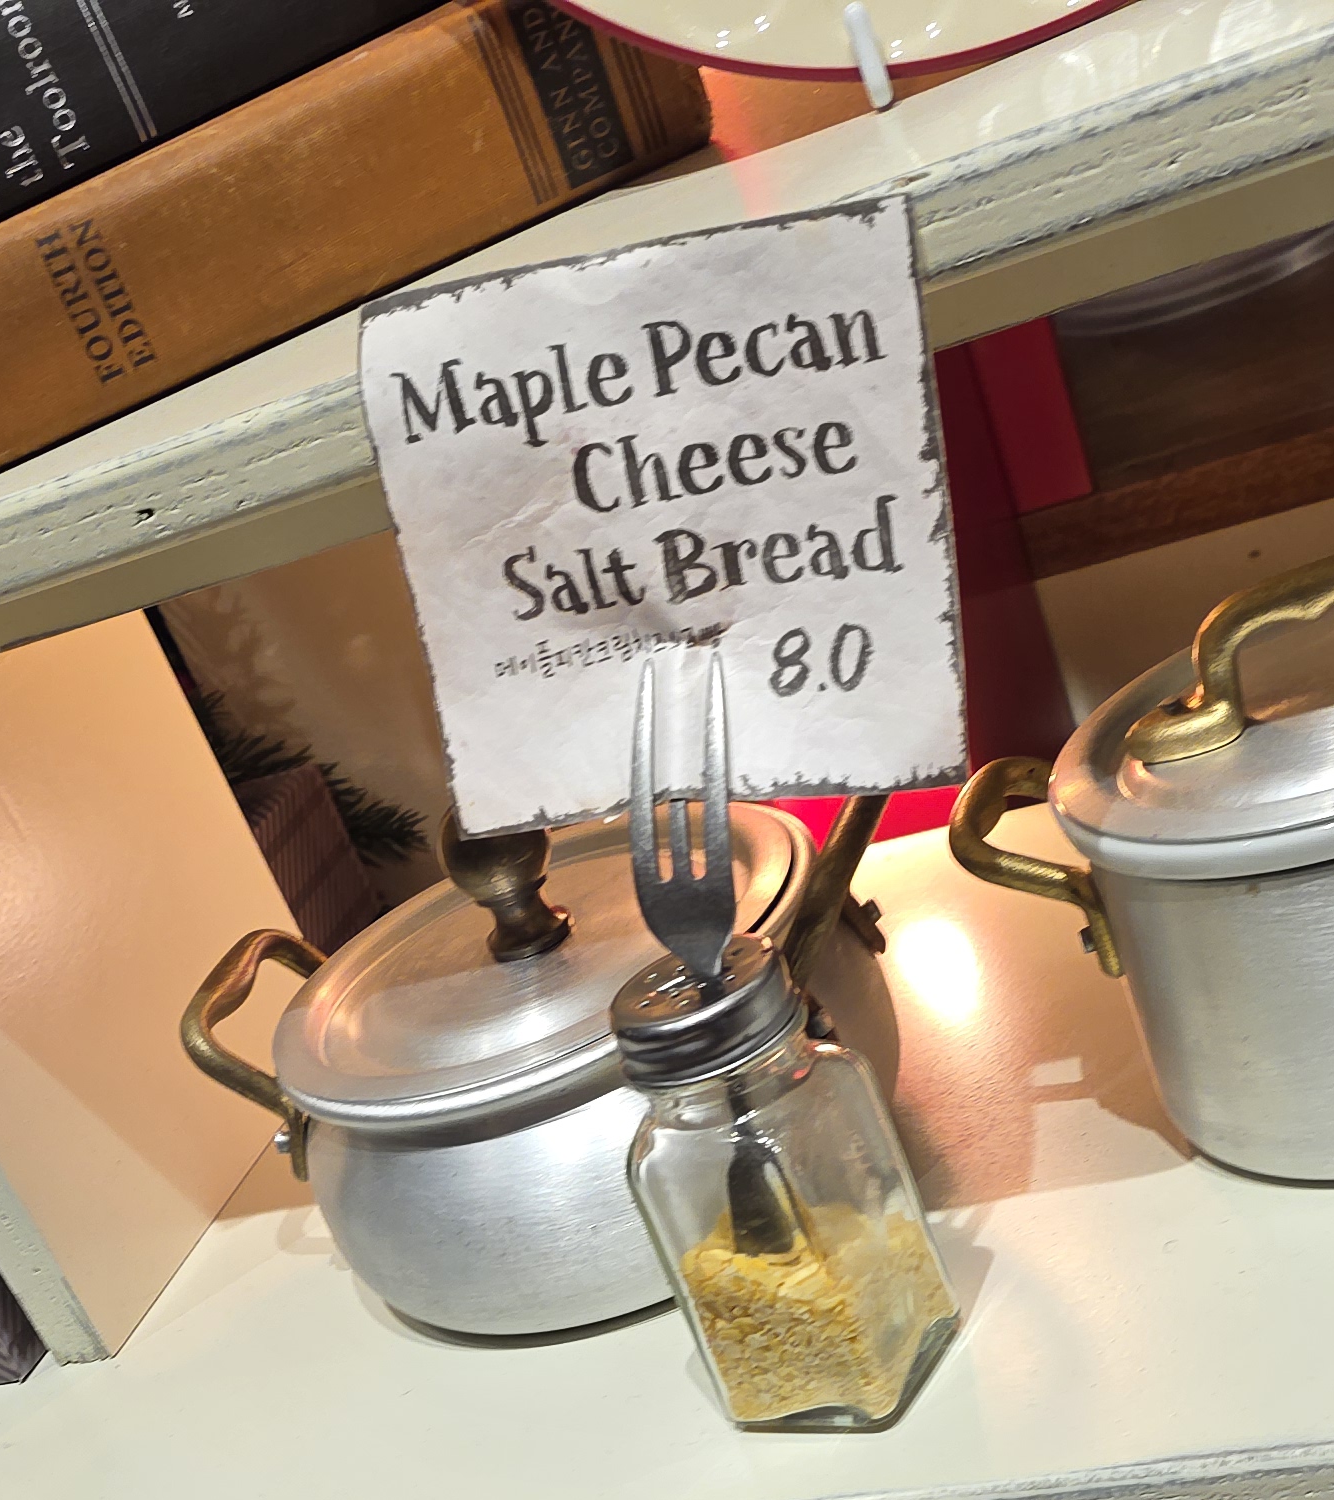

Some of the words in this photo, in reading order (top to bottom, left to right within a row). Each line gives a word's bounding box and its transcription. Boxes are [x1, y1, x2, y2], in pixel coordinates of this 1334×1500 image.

[523, 8, 562, 70] AND
[0, 125, 44, 187] the
[550, 86, 594, 171] GINN
[35, 230, 125, 384] FOURTH
[69, 219, 157, 368] EDITION
[390, 343, 633, 449] Maple
[642, 308, 887, 399] Pecan
[573, 420, 859, 515] Cheese
[503, 543, 647, 622] Salt
[657, 494, 904, 605] Bread
[768, 623, 875, 699] 8.0
